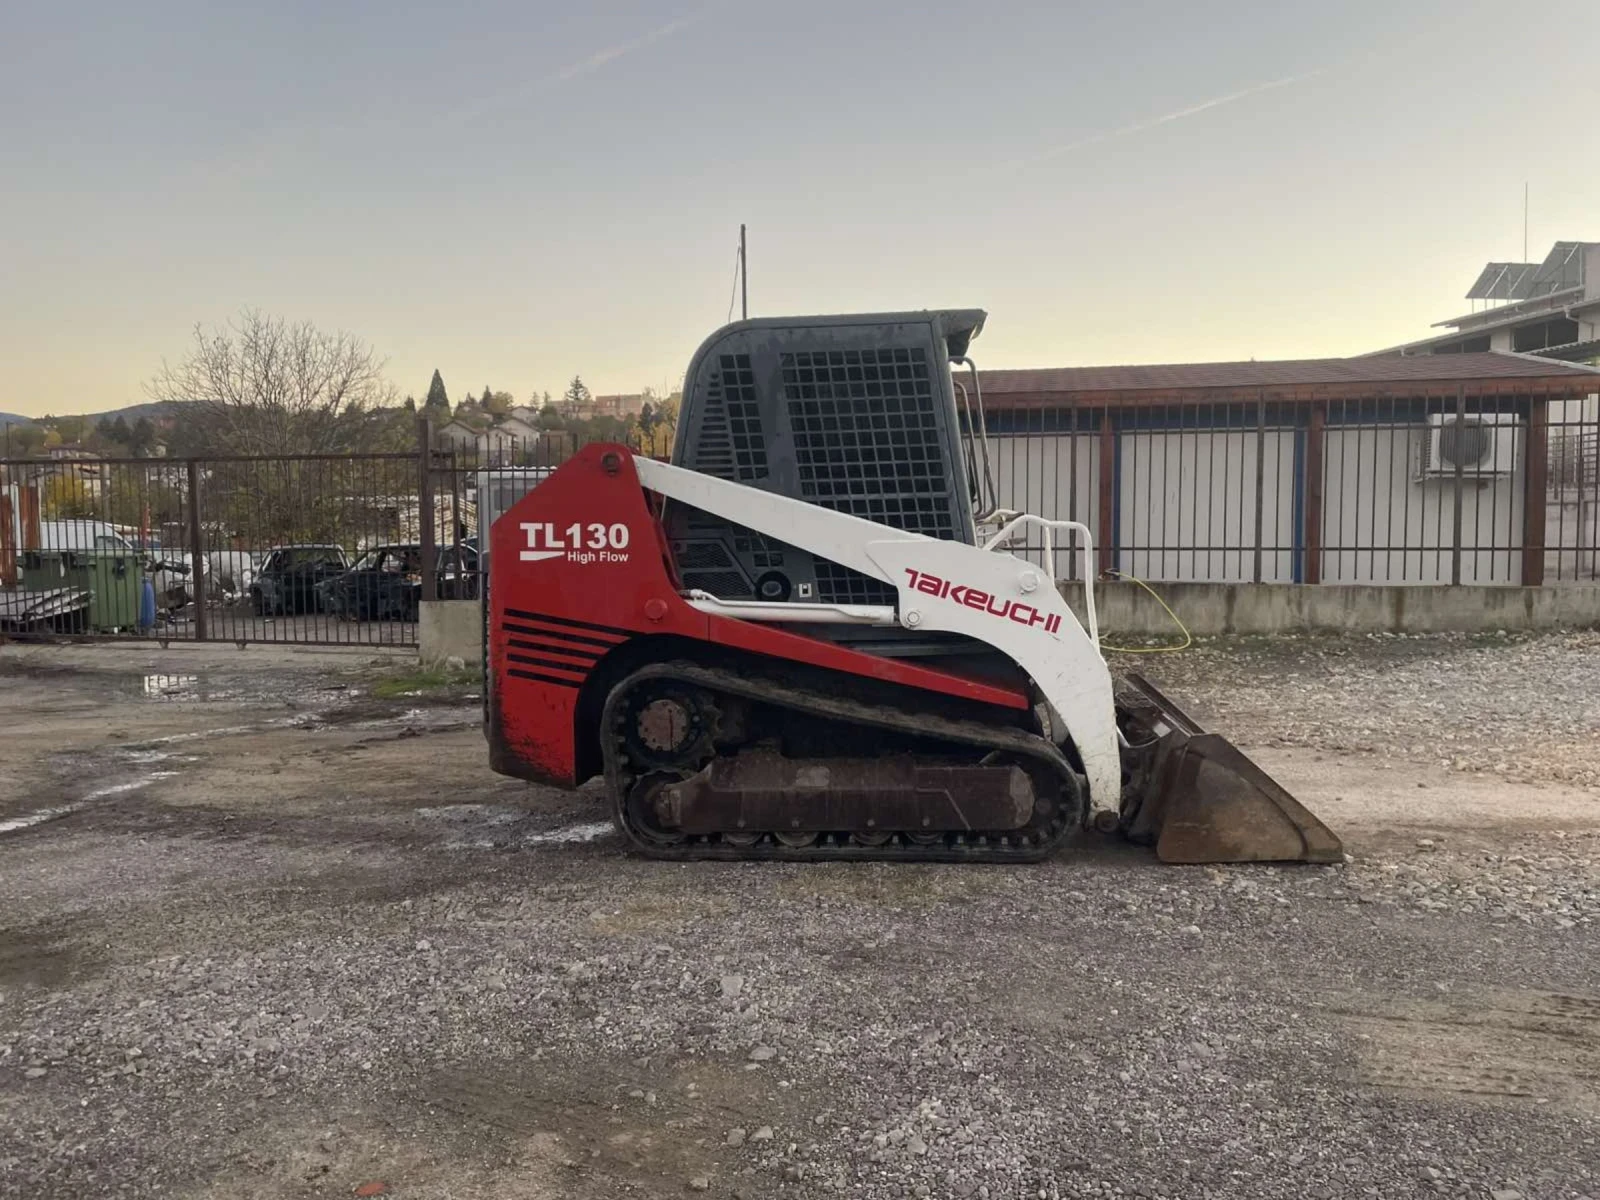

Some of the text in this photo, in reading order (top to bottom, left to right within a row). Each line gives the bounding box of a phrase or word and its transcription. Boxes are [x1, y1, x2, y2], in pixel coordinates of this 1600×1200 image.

[519, 522, 629, 549] TL130
[567, 551, 629, 565] High Flow
